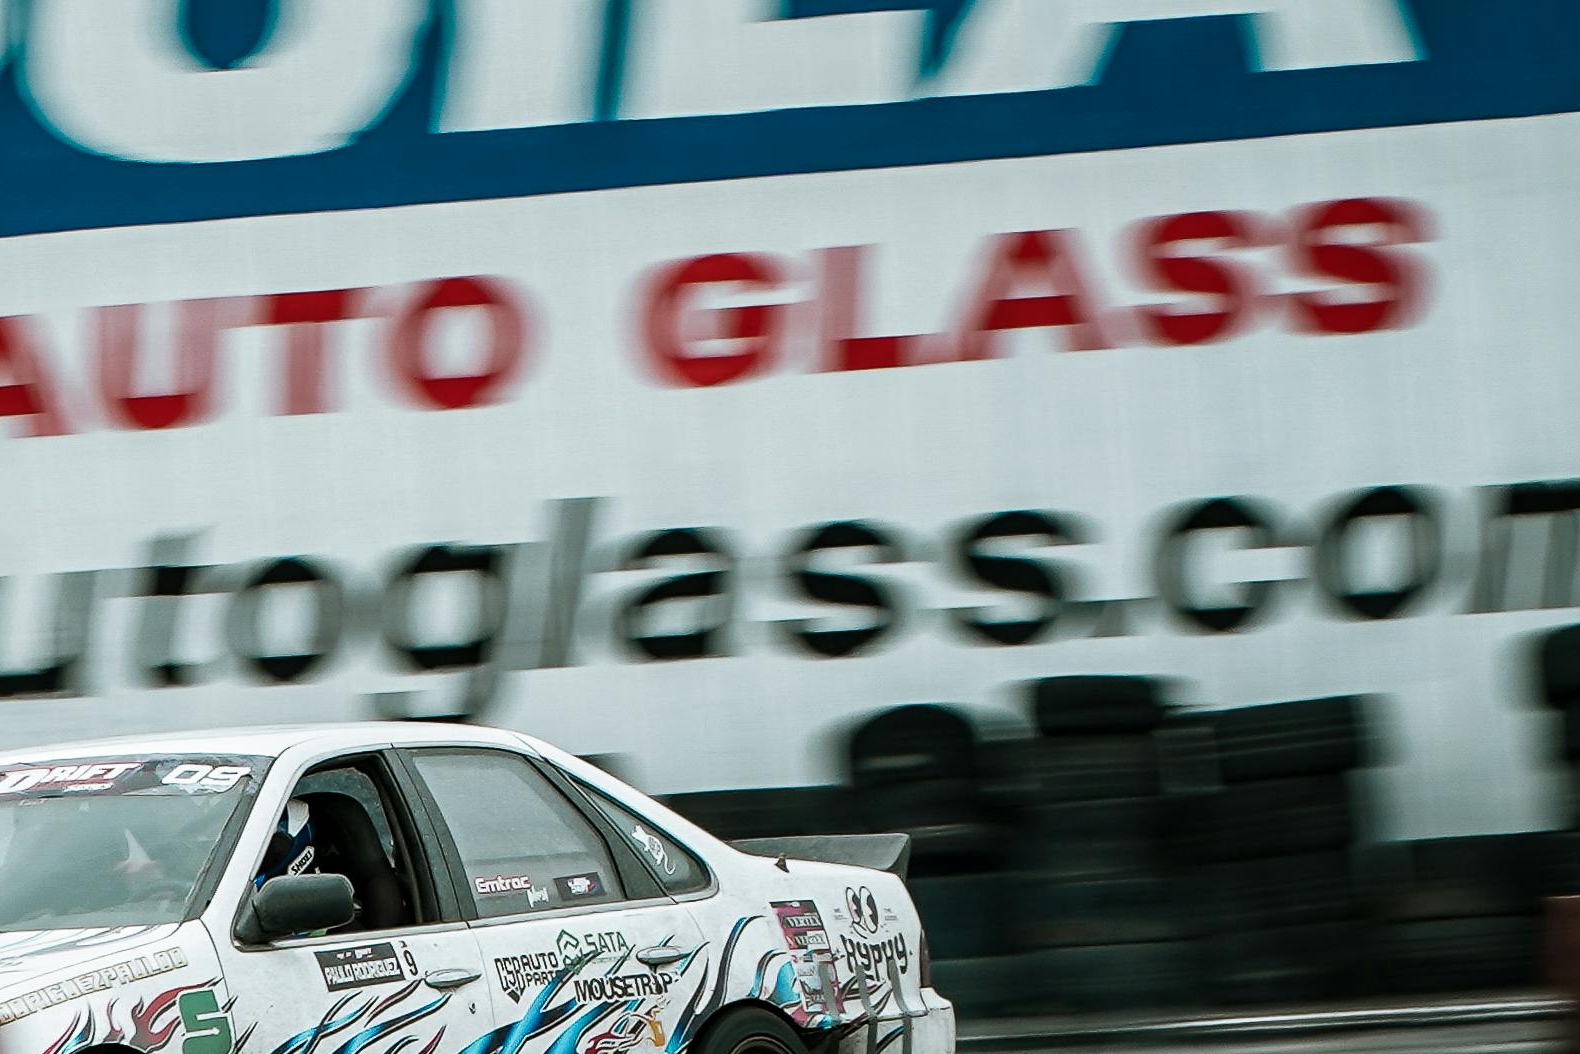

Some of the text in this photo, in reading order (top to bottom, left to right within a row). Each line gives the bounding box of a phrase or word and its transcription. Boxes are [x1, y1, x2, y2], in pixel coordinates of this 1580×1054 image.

[632, 197, 1438, 388] GLASS
[475, 875, 531, 894] Emtrac
[584, 931, 629, 954] SATA
[520, 951, 559, 973] AUTO
[526, 969, 561, 987] PART
